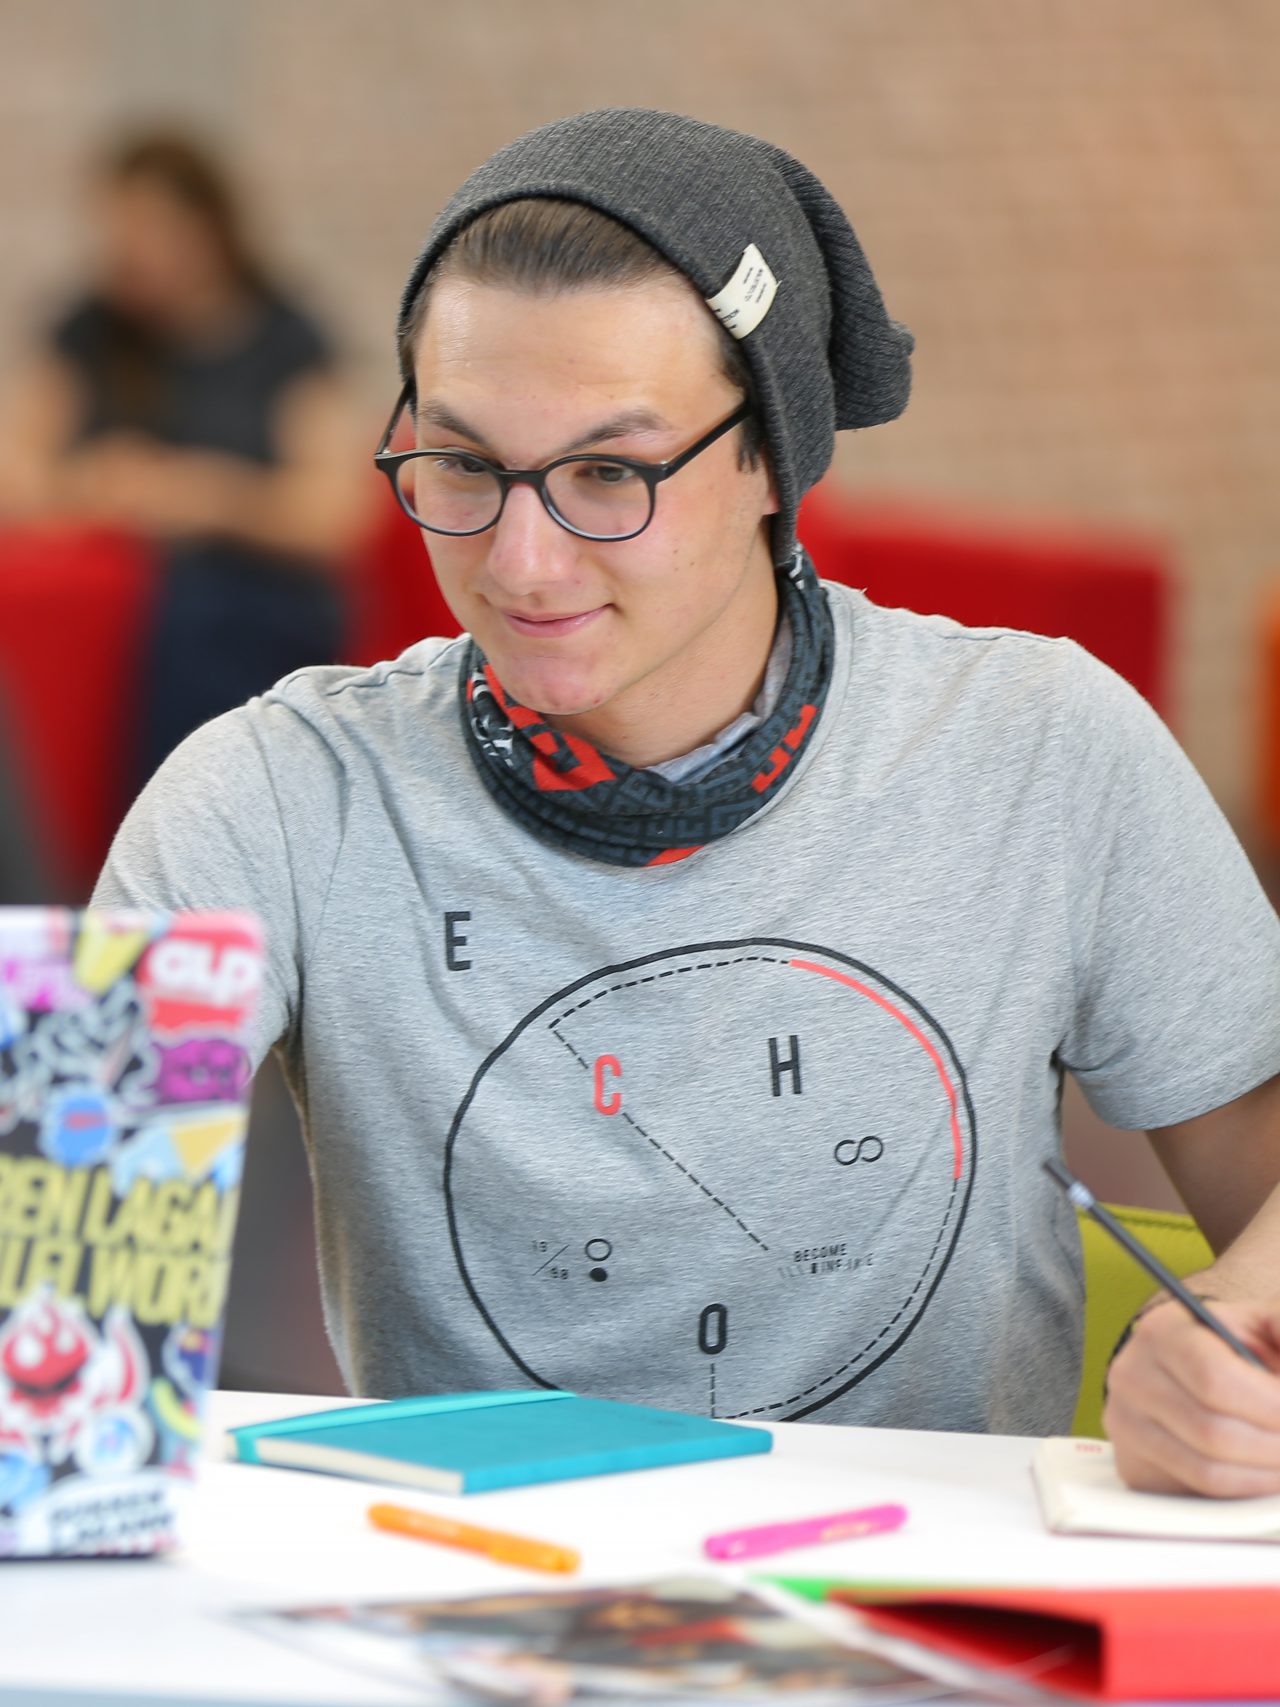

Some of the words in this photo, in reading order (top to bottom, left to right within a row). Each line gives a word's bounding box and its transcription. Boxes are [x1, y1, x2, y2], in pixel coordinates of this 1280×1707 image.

[444, 910, 472, 972] E
[593, 1054, 622, 1116] C
[767, 1034, 803, 1097] H
[793, 1243, 847, 1262] BECOME
[697, 1302, 728, 1355] O
